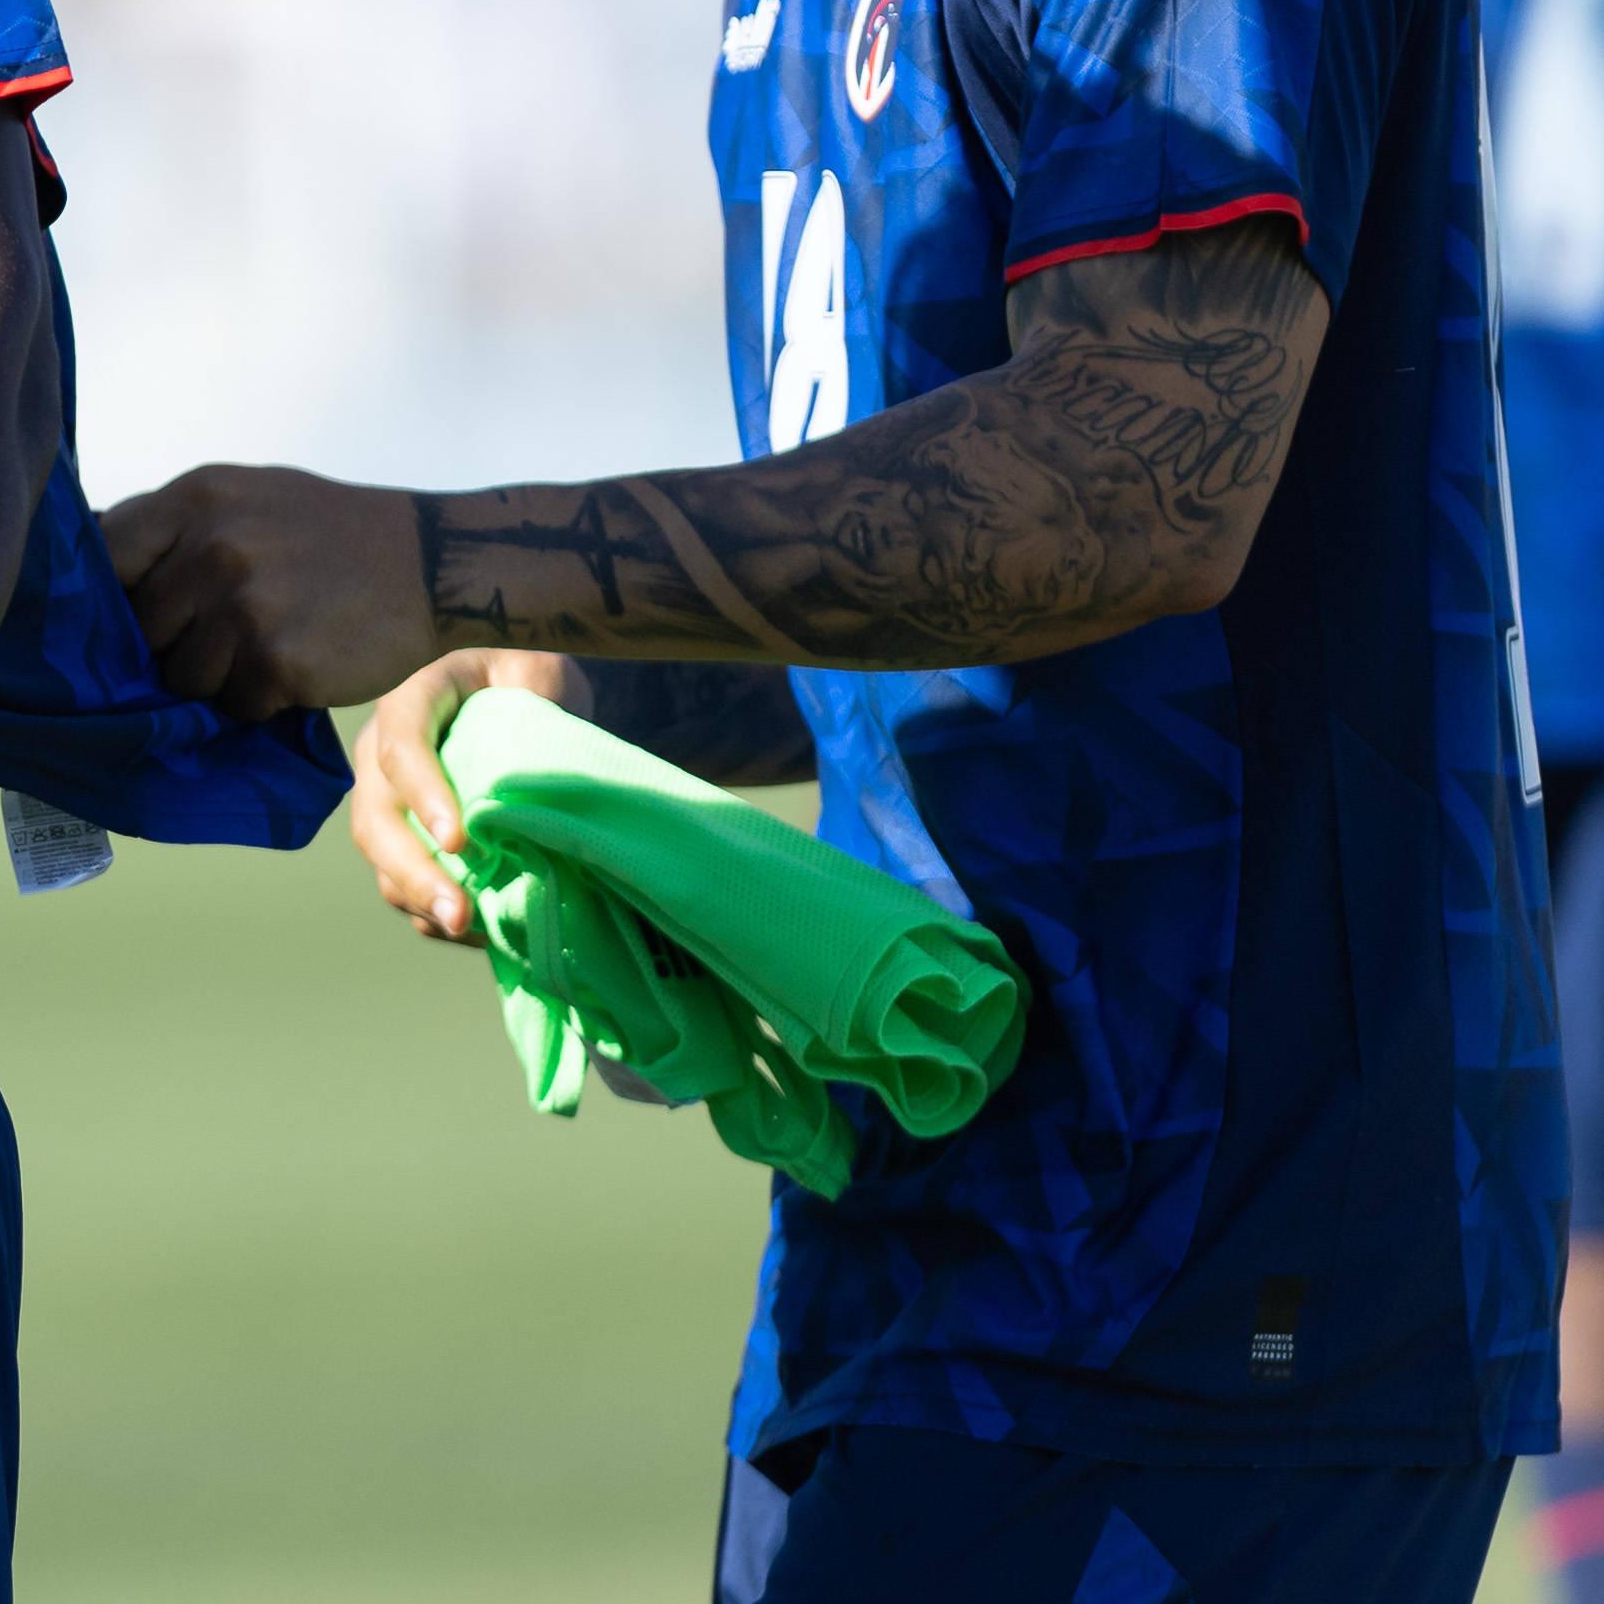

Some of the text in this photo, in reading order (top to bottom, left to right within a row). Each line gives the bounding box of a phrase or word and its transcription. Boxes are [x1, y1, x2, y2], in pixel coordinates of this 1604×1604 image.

[1254, 1333, 1293, 1341] AUTHENTIC
[1252, 1342, 1294, 1351] LICENSED
[1251, 1351, 1293, 1360] PRODUCT
